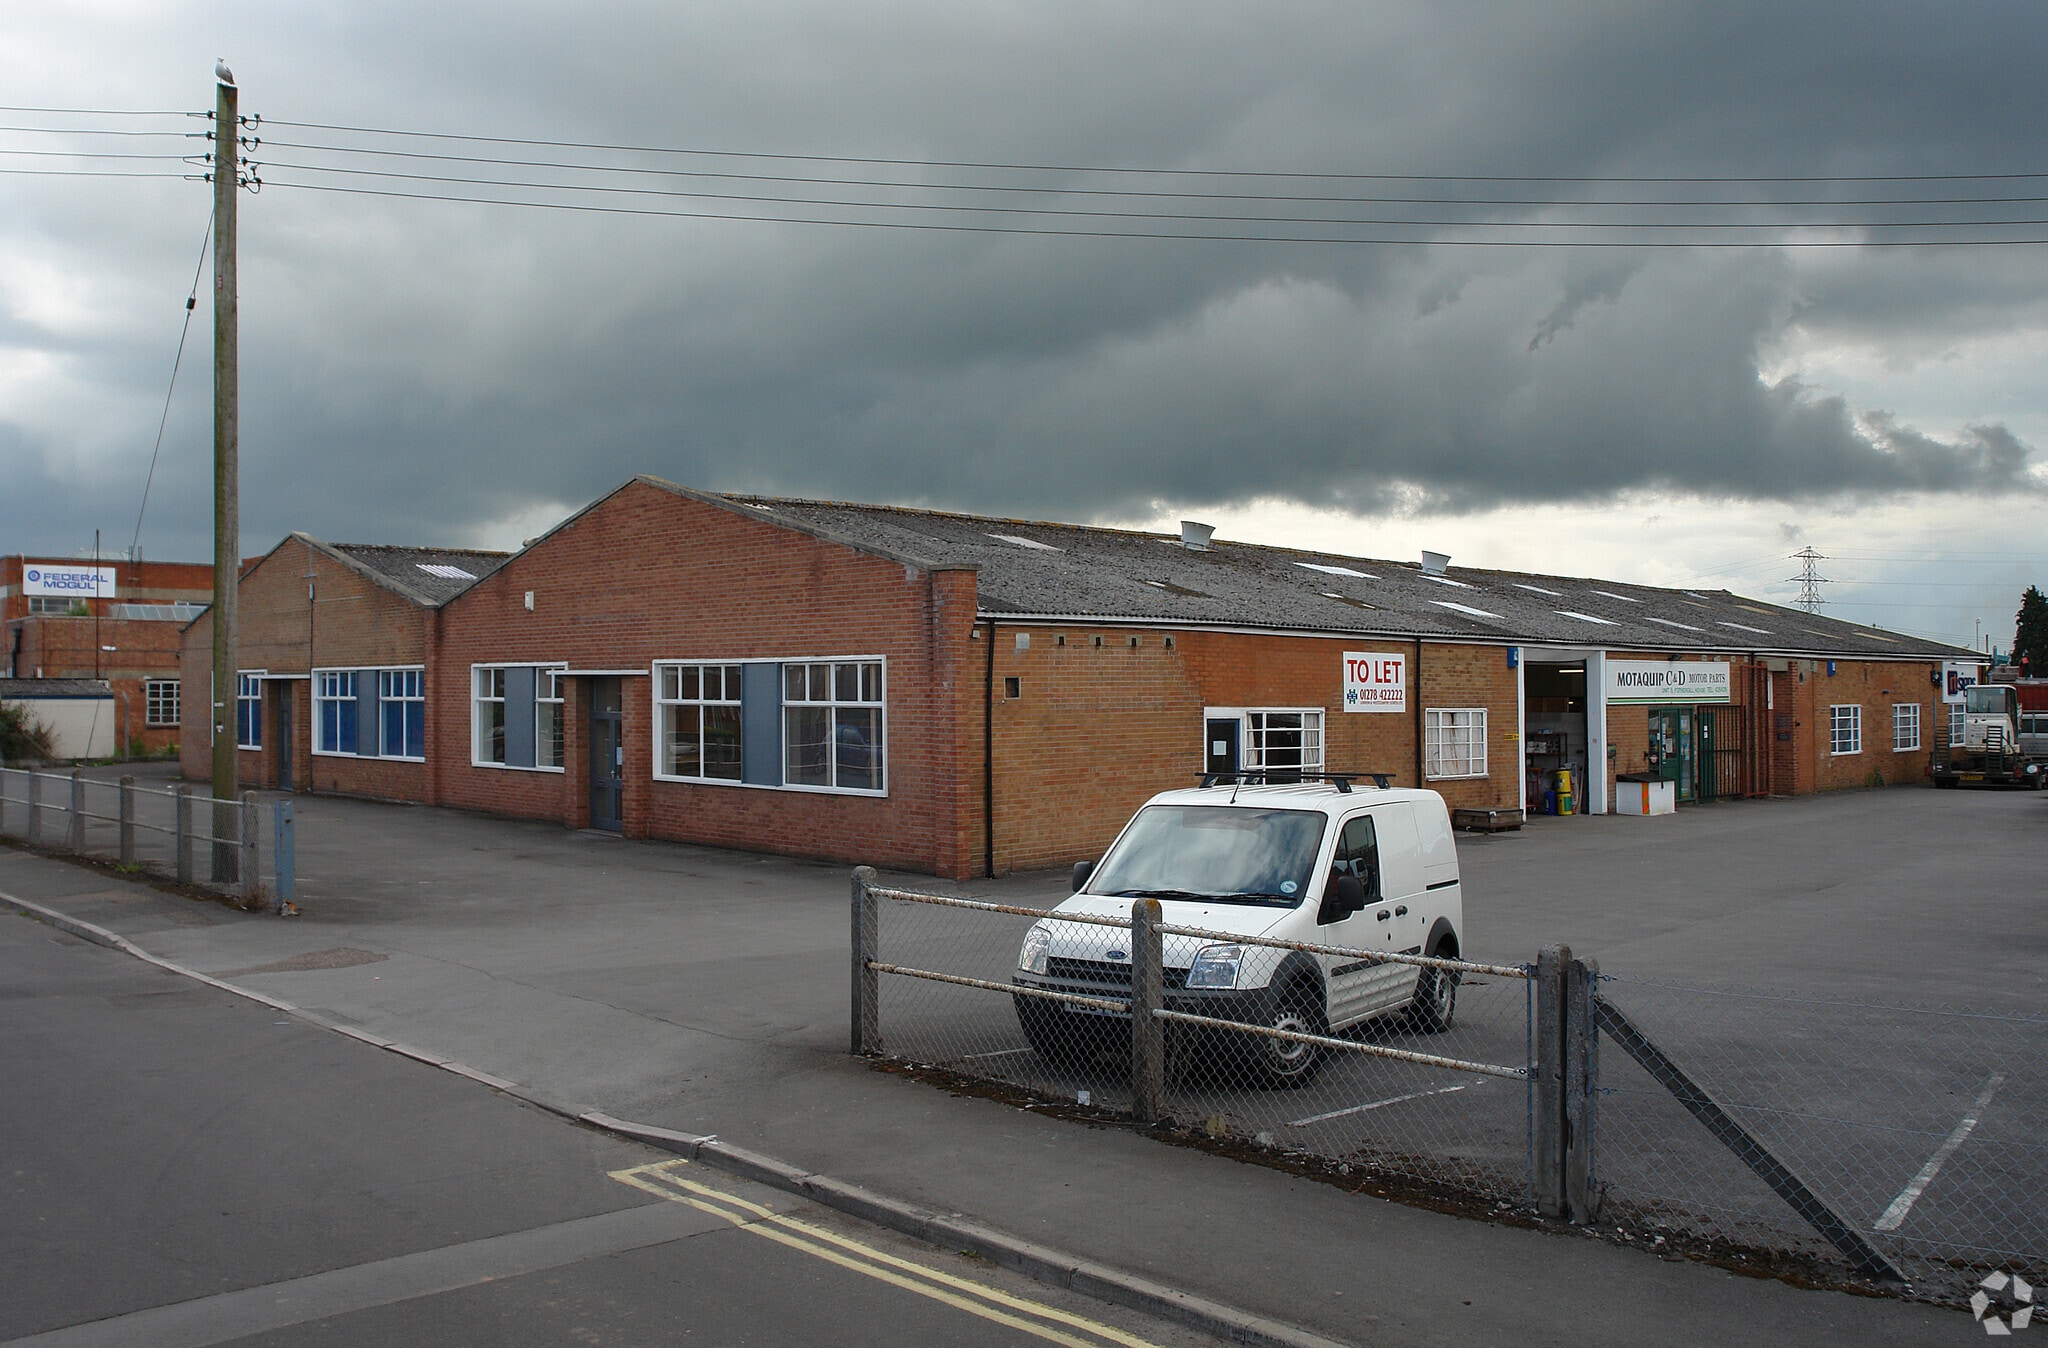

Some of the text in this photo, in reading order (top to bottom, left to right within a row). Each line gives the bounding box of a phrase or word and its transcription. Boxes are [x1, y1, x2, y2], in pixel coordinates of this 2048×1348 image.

[43, 573, 108, 583] FEDERAL
[43, 581, 96, 590] MOGUL
[1347, 659, 1402, 684] TO LET
[1617, 670, 1726, 687] MOTAQUIP C&D MOTOR PARTS
[1360, 689, 1403, 701] 01278 422222
